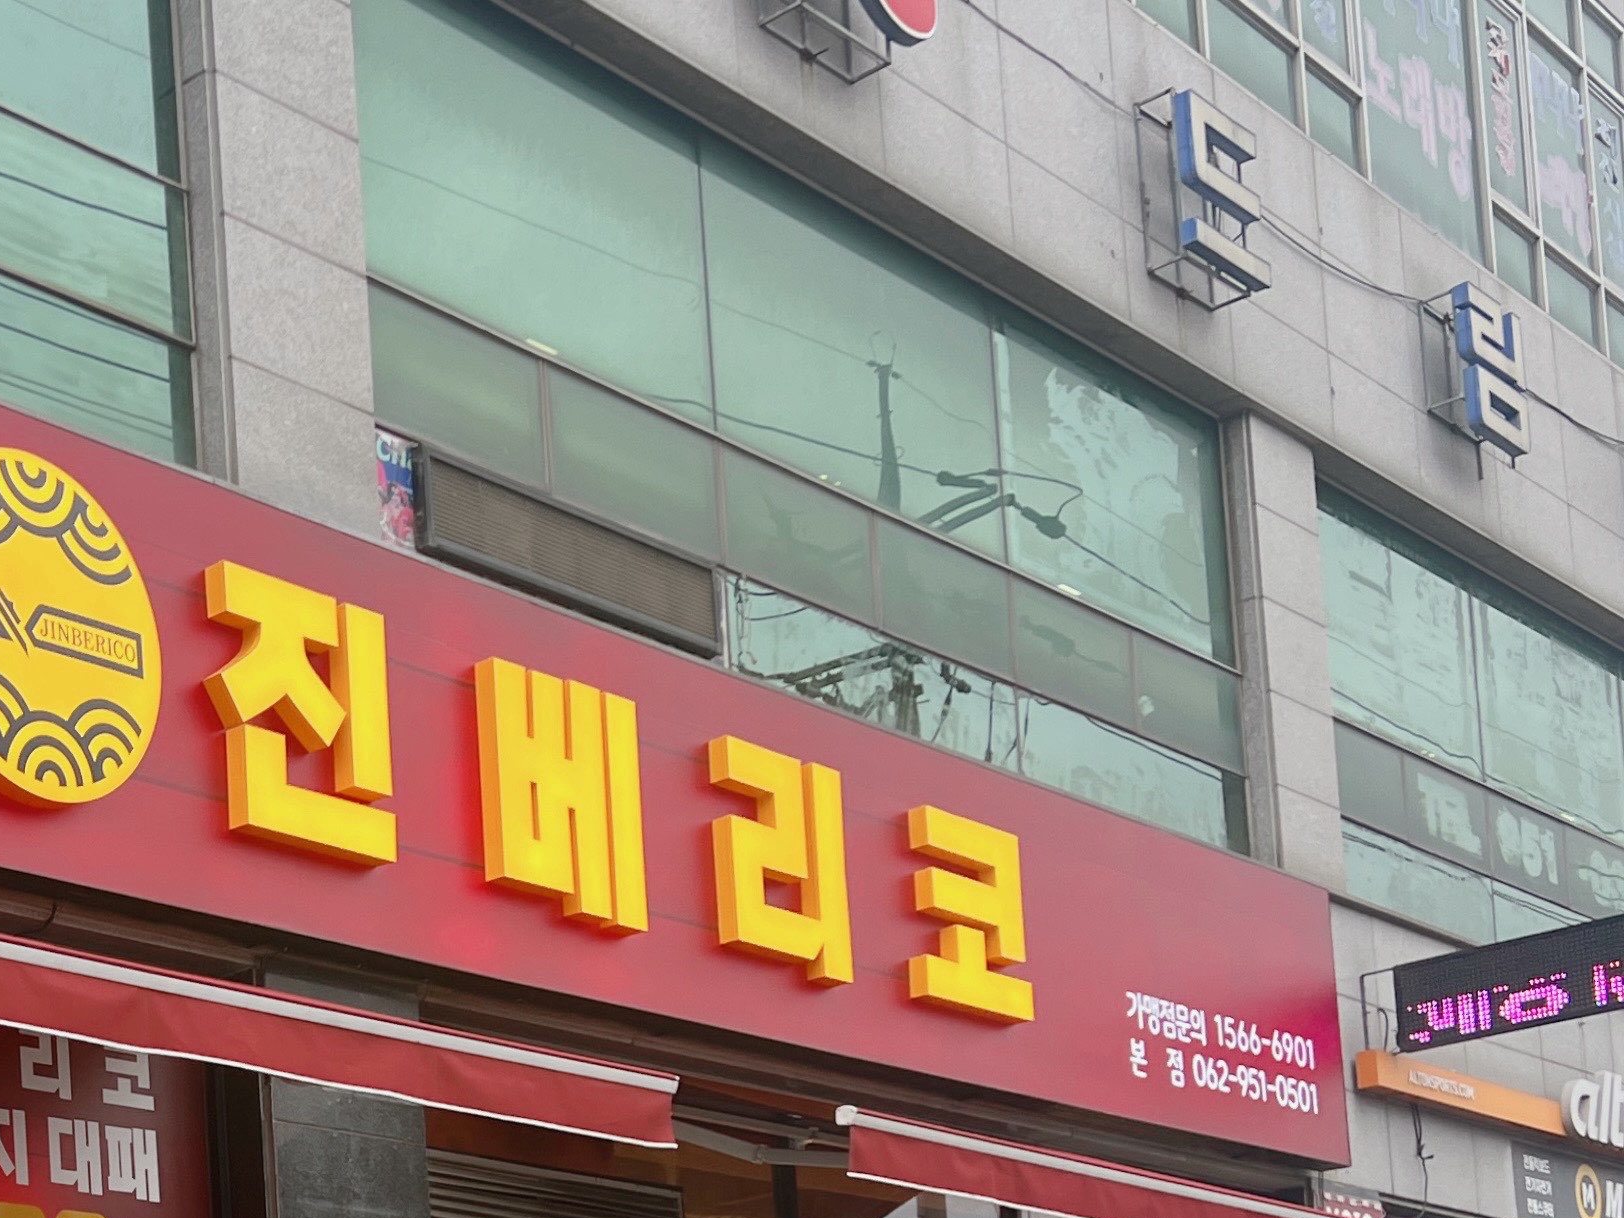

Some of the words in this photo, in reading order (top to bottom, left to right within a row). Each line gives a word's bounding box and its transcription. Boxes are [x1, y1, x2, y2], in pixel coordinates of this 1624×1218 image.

[40, 618, 136, 663] JINBERICO
[202, 557, 1035, 1025] 진베리코
[1417, 772, 1481, 857] TEL
[1126, 990, 1207, 1047] 가맹점문의
[1214, 1013, 1316, 1071] 1566-6901
[1191, 1053, 1319, 1115] 062-951-0501
[47, 1116, 162, 1203] 대패
